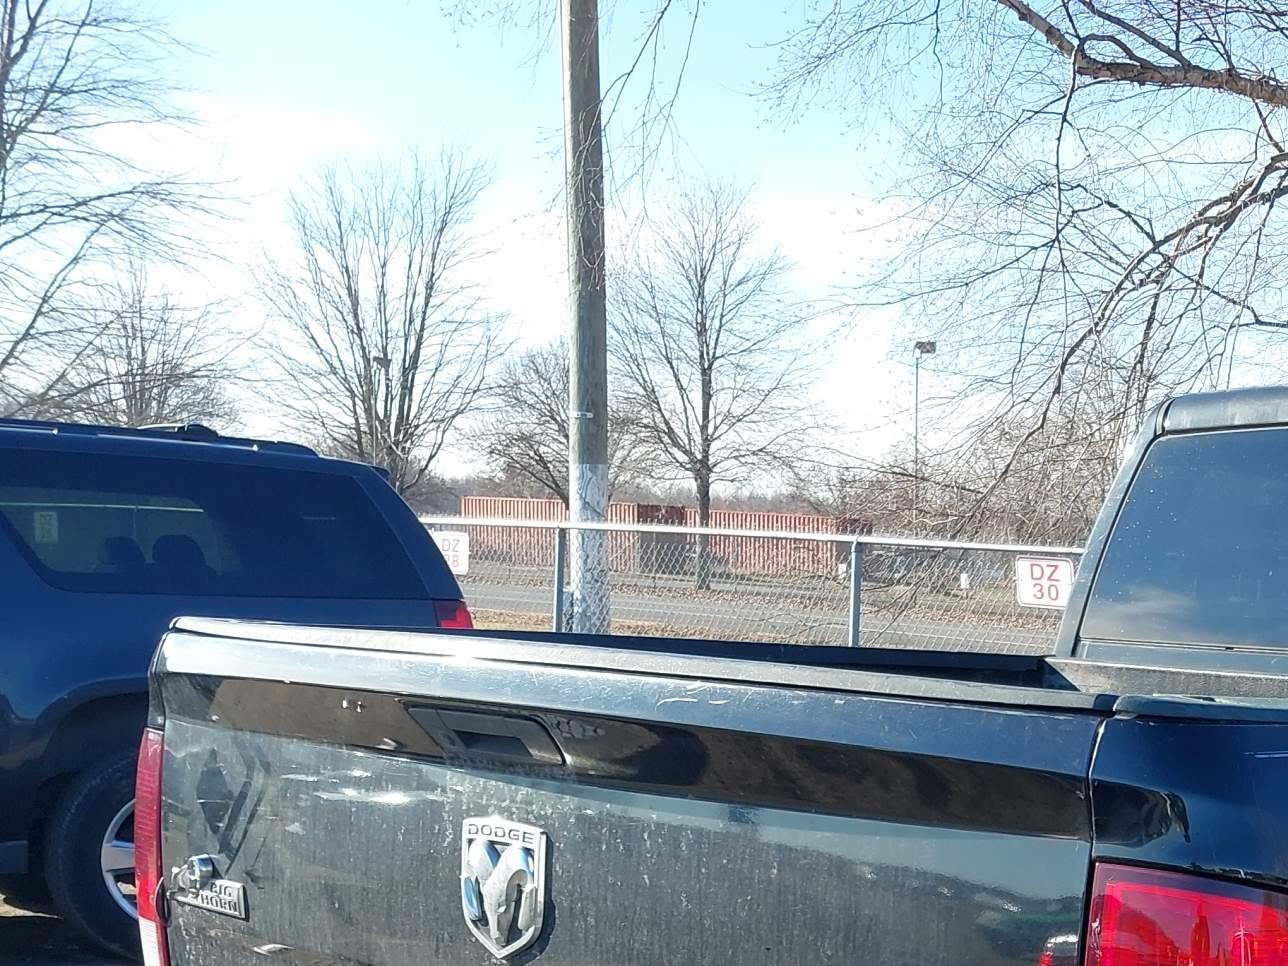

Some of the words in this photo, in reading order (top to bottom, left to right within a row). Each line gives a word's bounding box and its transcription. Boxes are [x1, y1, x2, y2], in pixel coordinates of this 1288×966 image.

[442, 538, 460, 552] DZ
[1030, 563, 1061, 582] DZ
[1033, 583, 1059, 601] 30
[468, 823, 535, 845] DODGE
[210, 881, 233, 898] BIG
[200, 893, 238, 912] HORN
